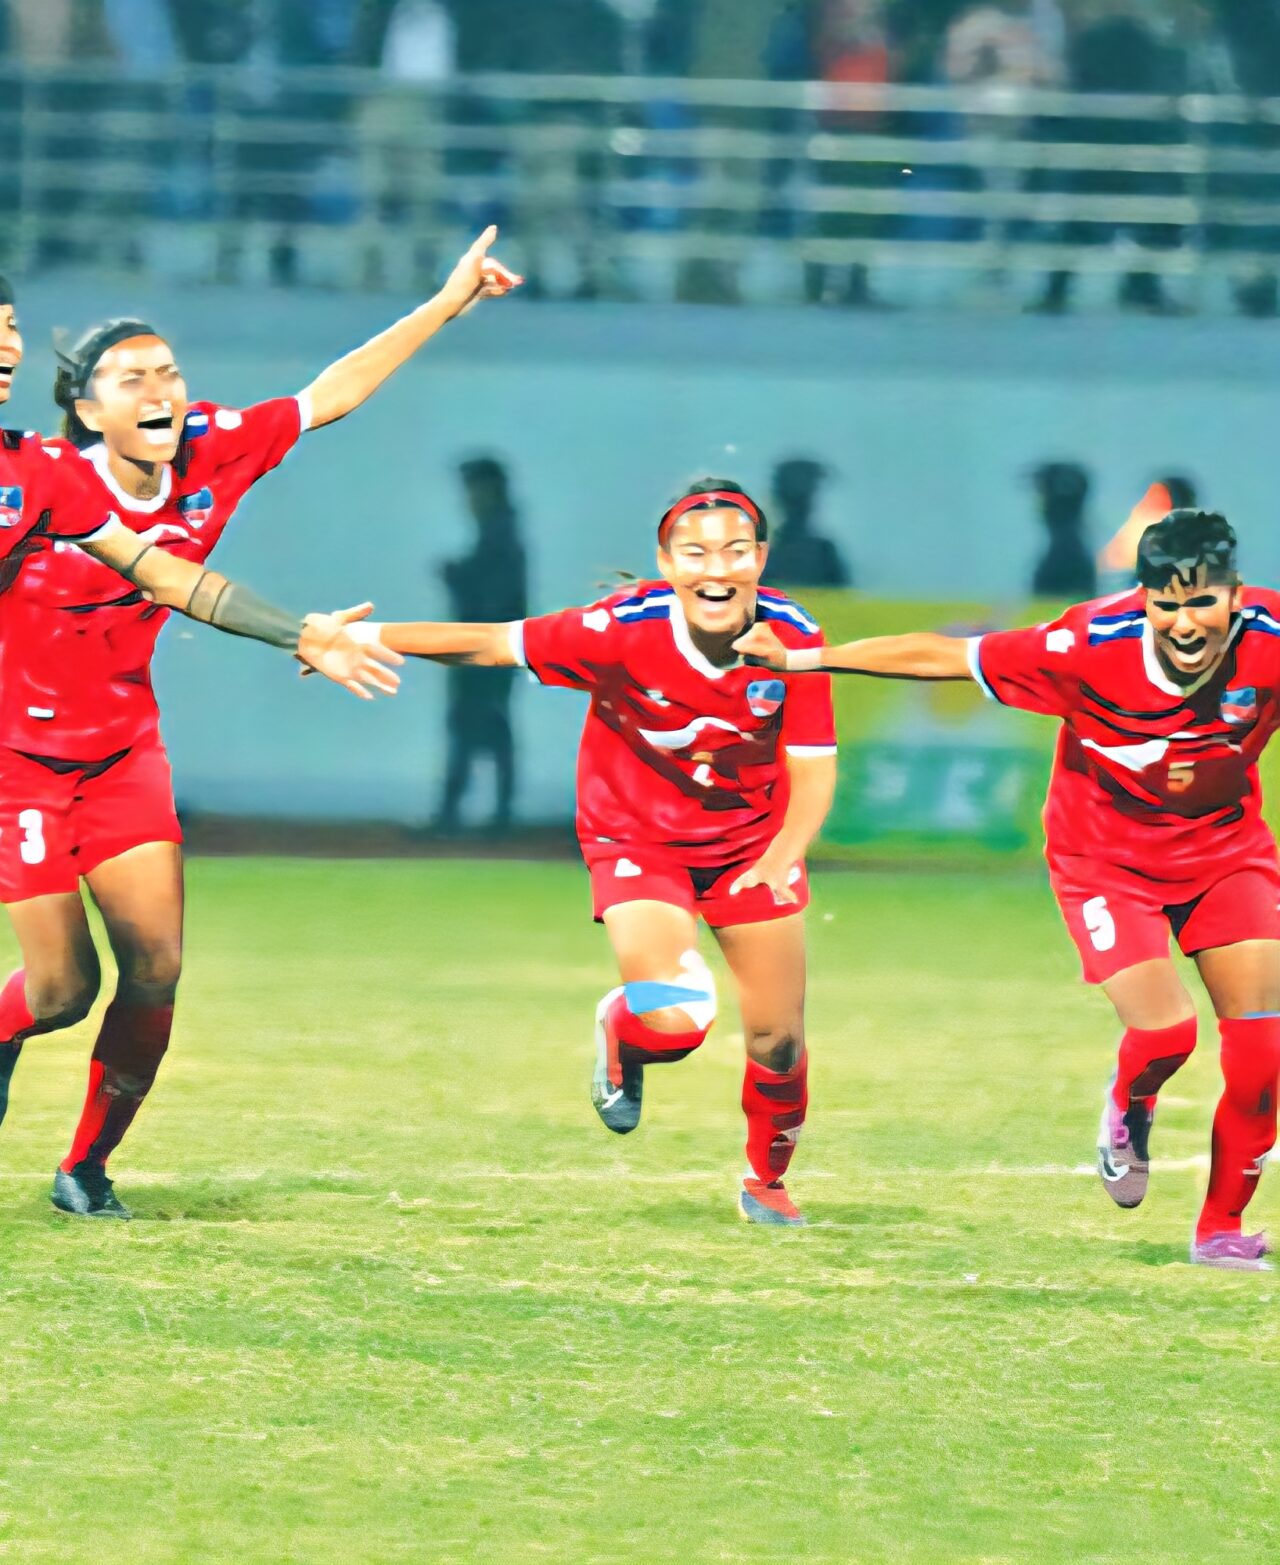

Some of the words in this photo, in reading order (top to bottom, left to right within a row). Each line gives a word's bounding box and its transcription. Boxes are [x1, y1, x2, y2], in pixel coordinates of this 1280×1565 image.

[1167, 761, 1195, 793] 5
[18, 808, 47, 865] 3
[1082, 895, 1117, 953] 5
